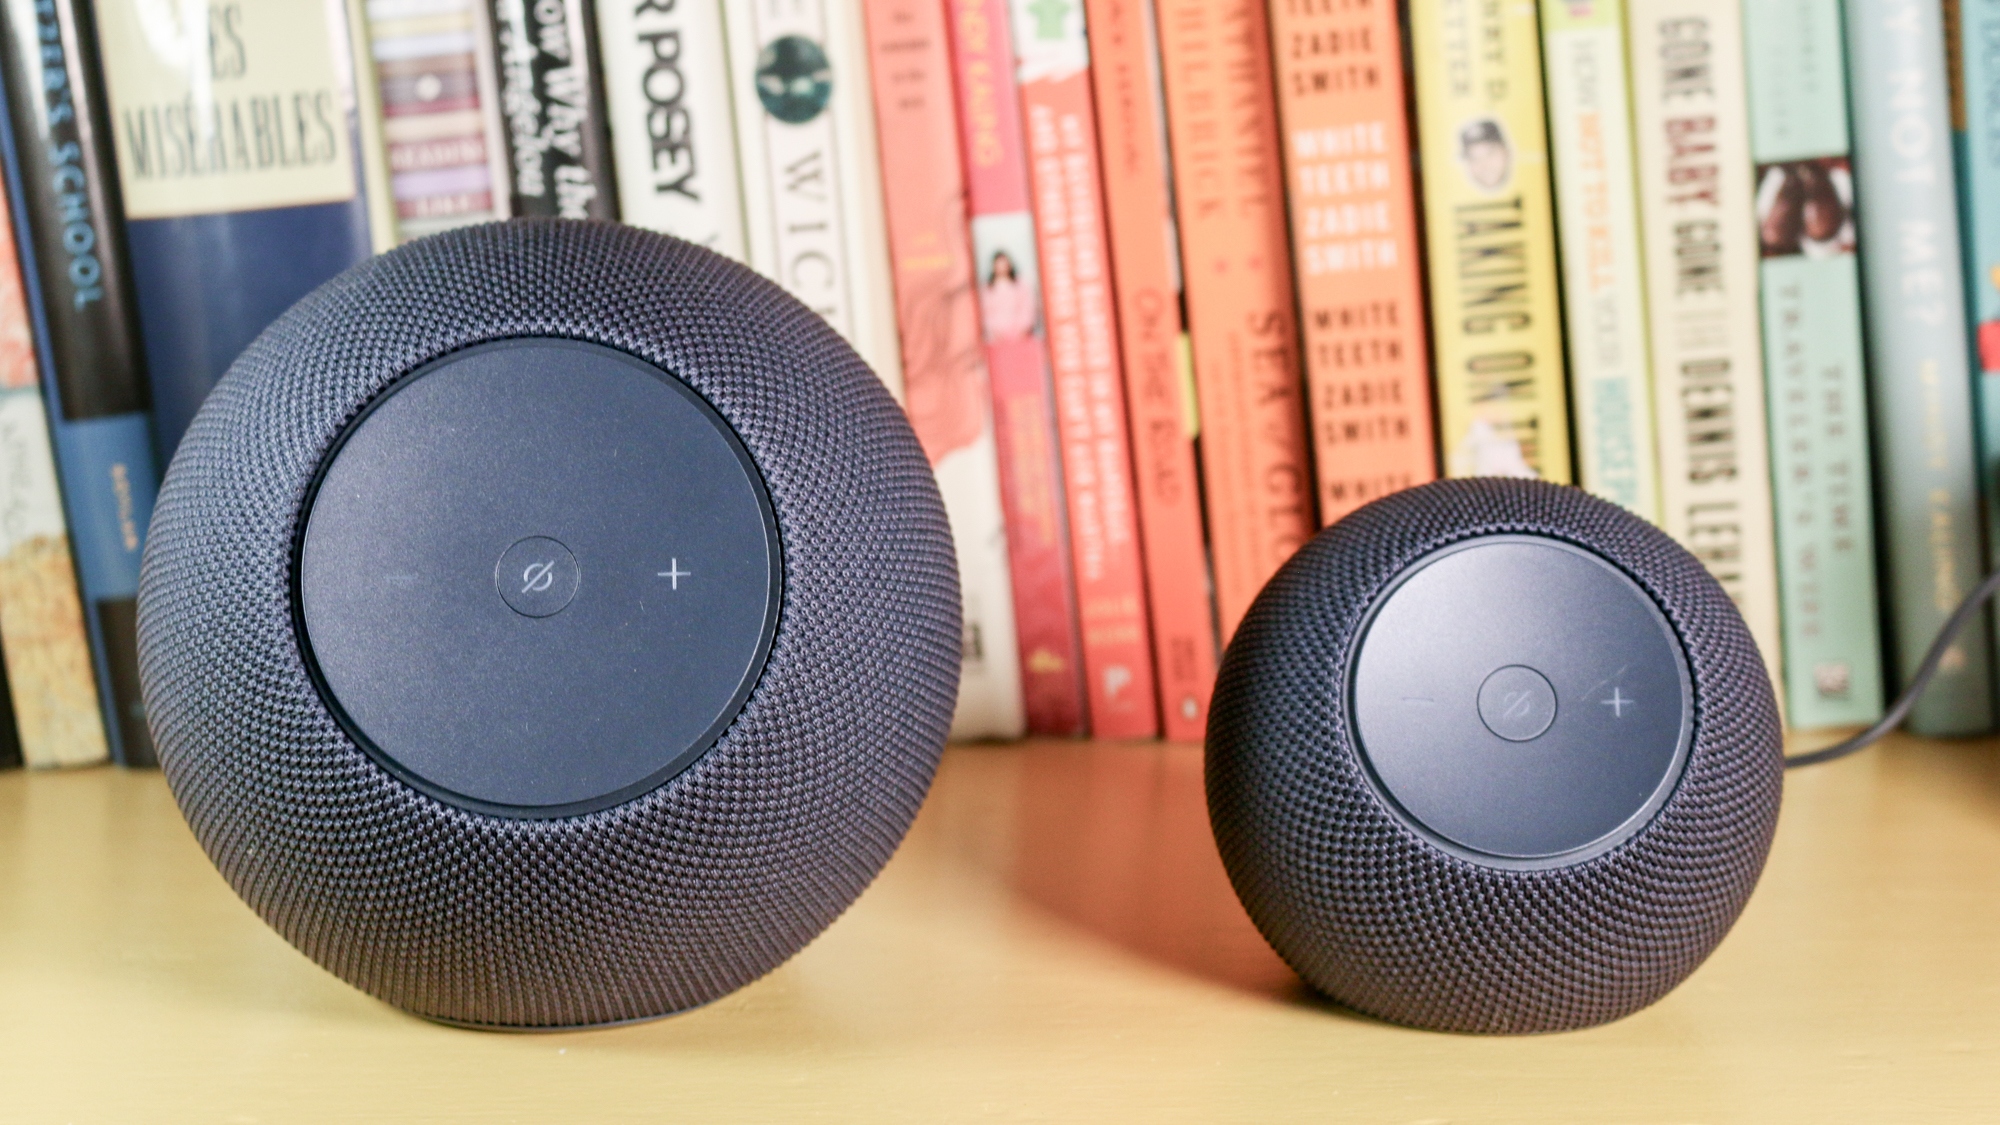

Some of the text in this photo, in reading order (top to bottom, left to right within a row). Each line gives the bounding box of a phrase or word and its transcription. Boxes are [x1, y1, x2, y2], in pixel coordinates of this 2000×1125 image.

[1292, 26, 1371, 60] ZADIE
[1292, 66, 1380, 97] SMITH
[1658, 15, 1714, 100] GONE
[542, 66, 587, 158] Why
[637, 30, 701, 203] POSEY
[1293, 121, 1386, 160] WHITE
[1889, 66, 1937, 185] NOT
[1298, 160, 1391, 198] TEETH
[1664, 115, 1720, 207] BABY
[50, 141, 104, 312] SCHOOL
[1304, 200, 1391, 239] ZADIE
[1307, 239, 1399, 277] SMITH
[1673, 219, 1725, 297] GONE
[1455, 196, 1532, 337] TAKING
[1900, 219, 1947, 325] ME?
[1314, 301, 1401, 331] WHITE
[1319, 334, 1402, 368] TEETH
[1132, 288, 1182, 505] ON THE ROAD
[1246, 310, 1292, 408] SEA
[1324, 379, 1403, 411] ZADIE
[1464, 350, 1538, 405] ON
[1327, 416, 1411, 446] SMITH
[1680, 358, 1737, 484] DENNIS
[1820, 363, 1857, 552] THE TIME
